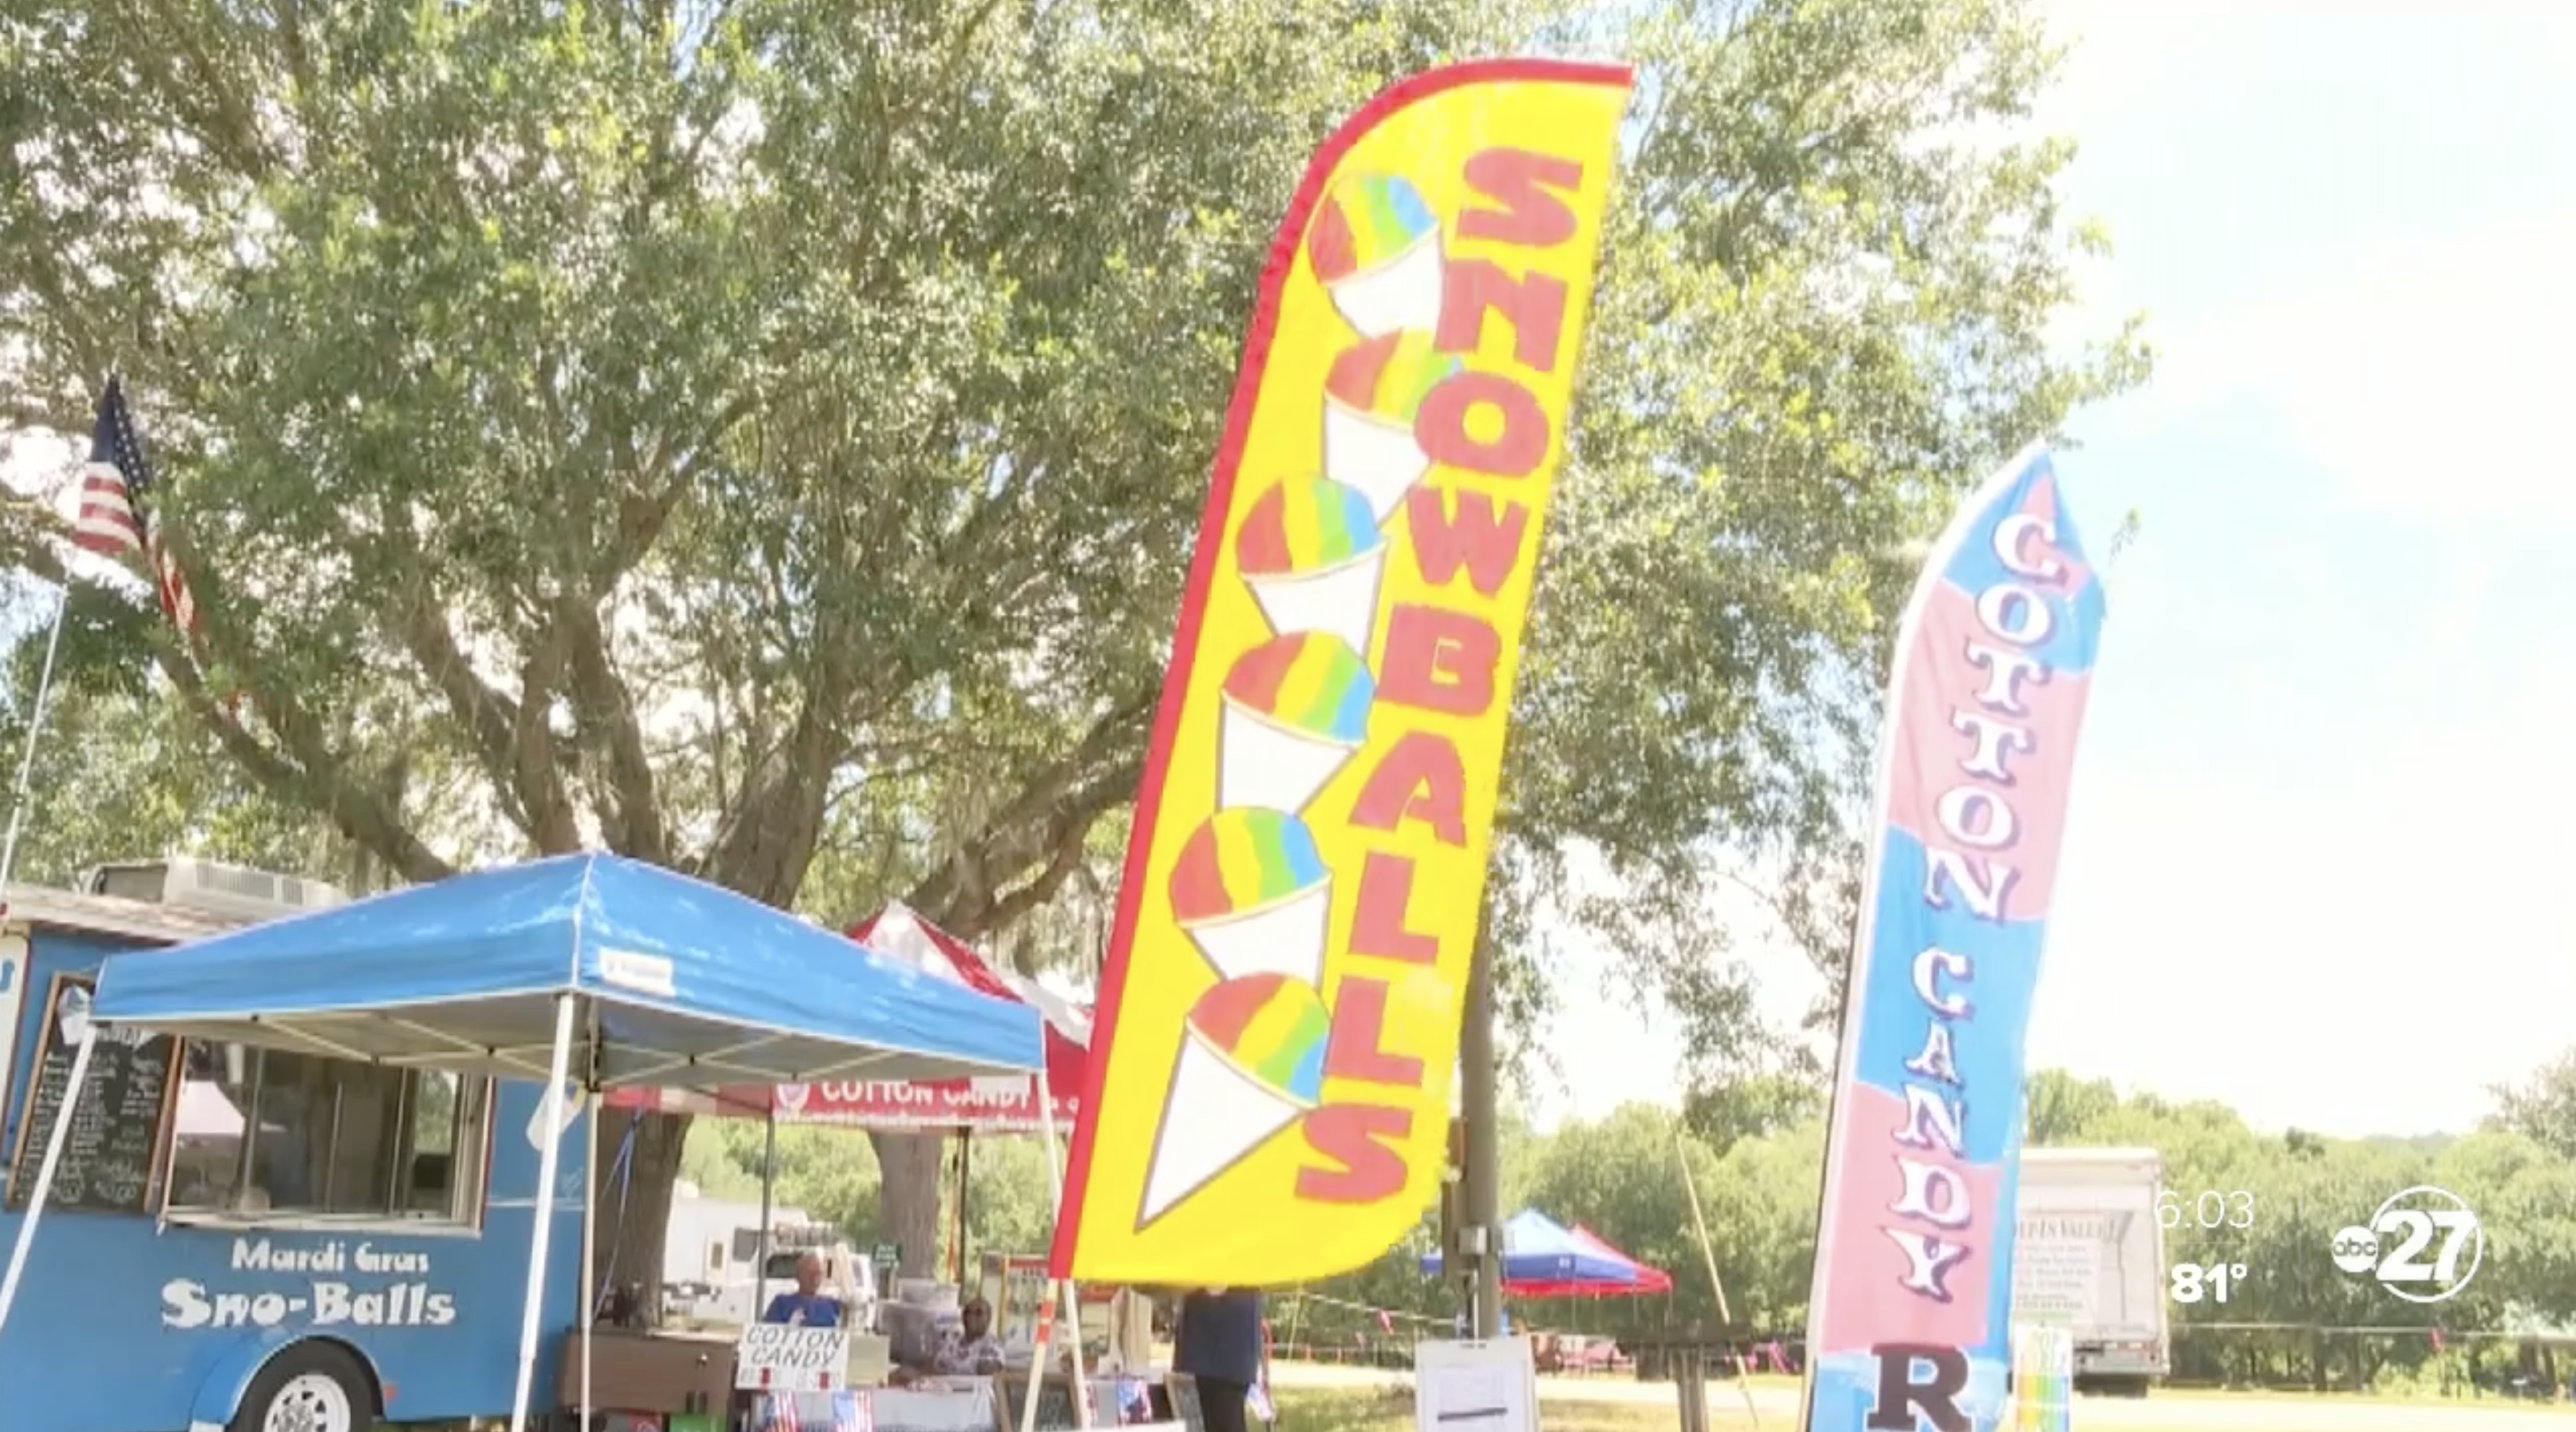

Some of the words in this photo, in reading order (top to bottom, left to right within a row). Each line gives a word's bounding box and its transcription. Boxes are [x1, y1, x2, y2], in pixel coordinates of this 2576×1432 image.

[1294, 146, 1583, 1205] SNOWBALLS
[1922, 512, 2069, 926] COTTON
[821, 1080, 934, 1106] COTTON
[1877, 944, 1976, 1304] CANDY
[231, 1237, 346, 1272] Mardi
[354, 1241, 430, 1273] Gras
[160, 1278, 457, 1328] Sno-Balls
[747, 1324, 844, 1350] COTTON
[751, 1346, 837, 1368] CANDY
